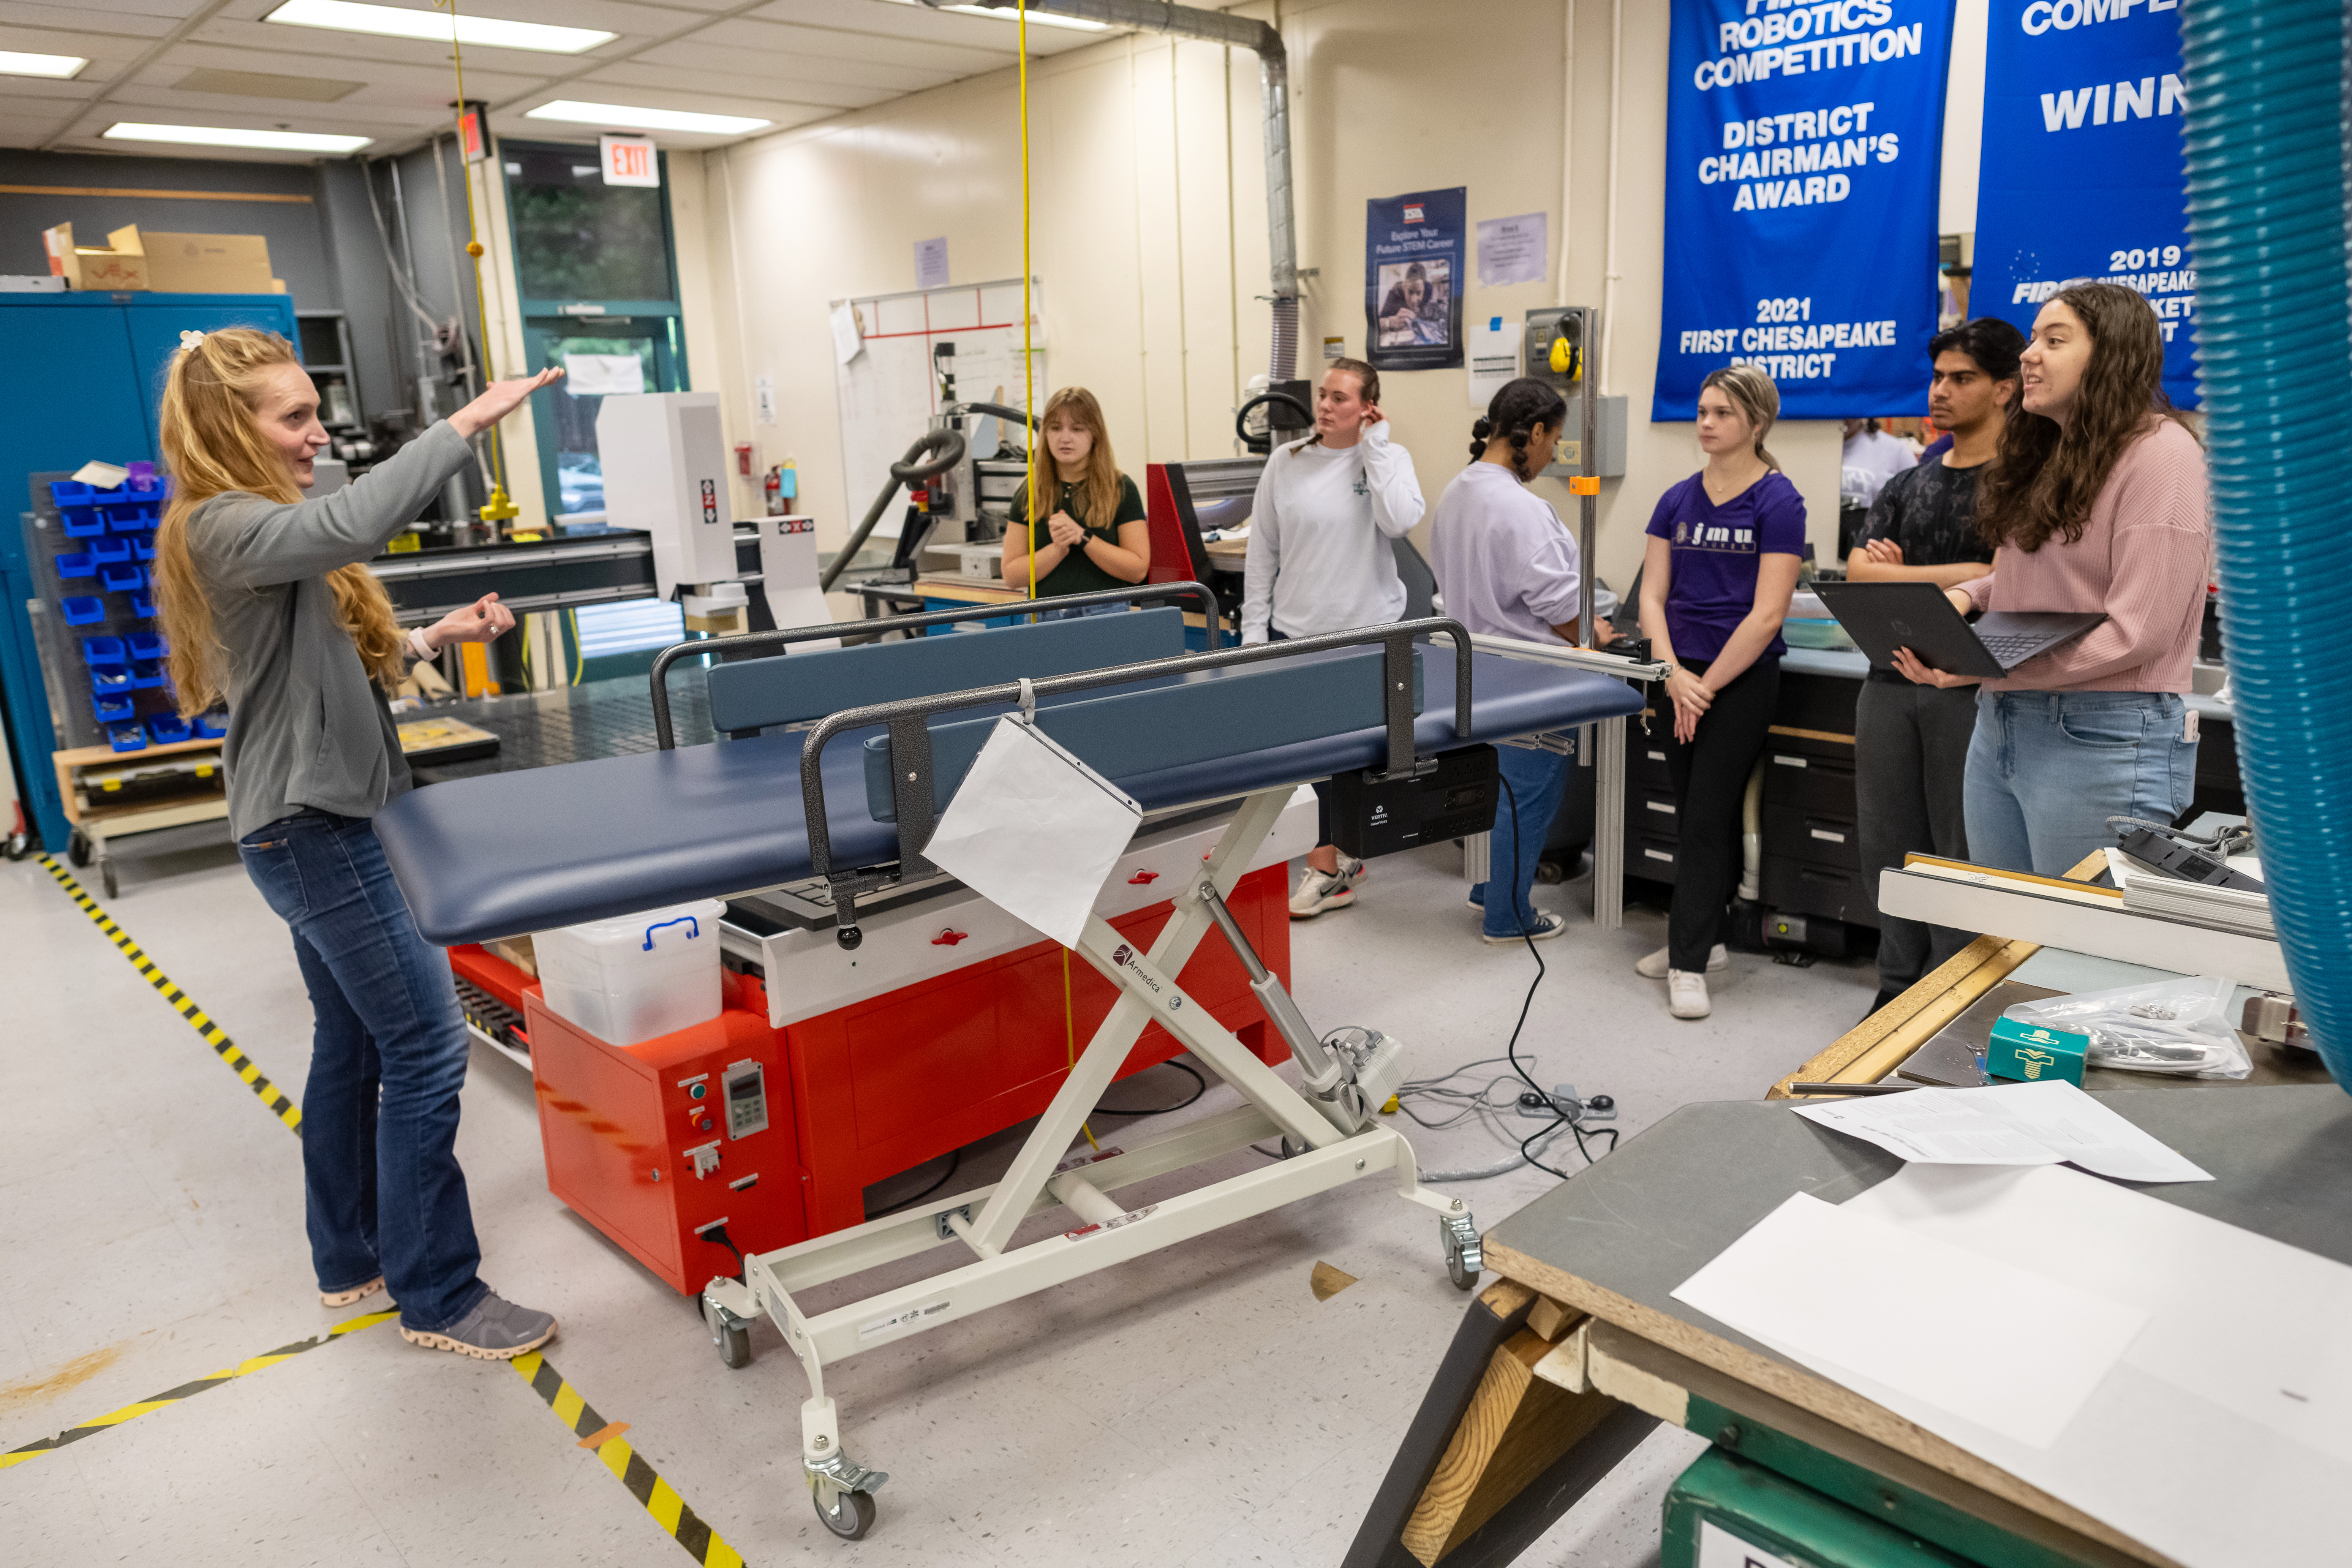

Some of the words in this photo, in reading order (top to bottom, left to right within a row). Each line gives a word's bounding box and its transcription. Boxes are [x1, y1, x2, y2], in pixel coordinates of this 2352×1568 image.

[1720, 0, 1892, 53] ROBOTICS
[1694, 22, 1922, 92] COMPETITION
[2040, 73, 2189, 132] WINN
[1723, 101, 1874, 149] DISTRICT
[610, 143, 648, 177] EXIT
[1698, 132, 1899, 185] CHAIRMAN'S
[1732, 173, 1851, 212] AWARD
[1375, 243, 1402, 254] Future
[1402, 240, 1426, 252] STEM
[1426, 239, 1455, 250] Career
[1391, 229, 1419, 242] Explore
[1419, 228, 1439, 238] Your
[2109, 245, 2181, 272] 2019
[1756, 297, 1811, 323] 2021
[1680, 328, 1738, 354] FIRST
[1742, 320, 1896, 352] CHESAPEAKE
[1731, 353, 1836, 379] STRICT
[1127, 960, 1160, 993] Armedica
